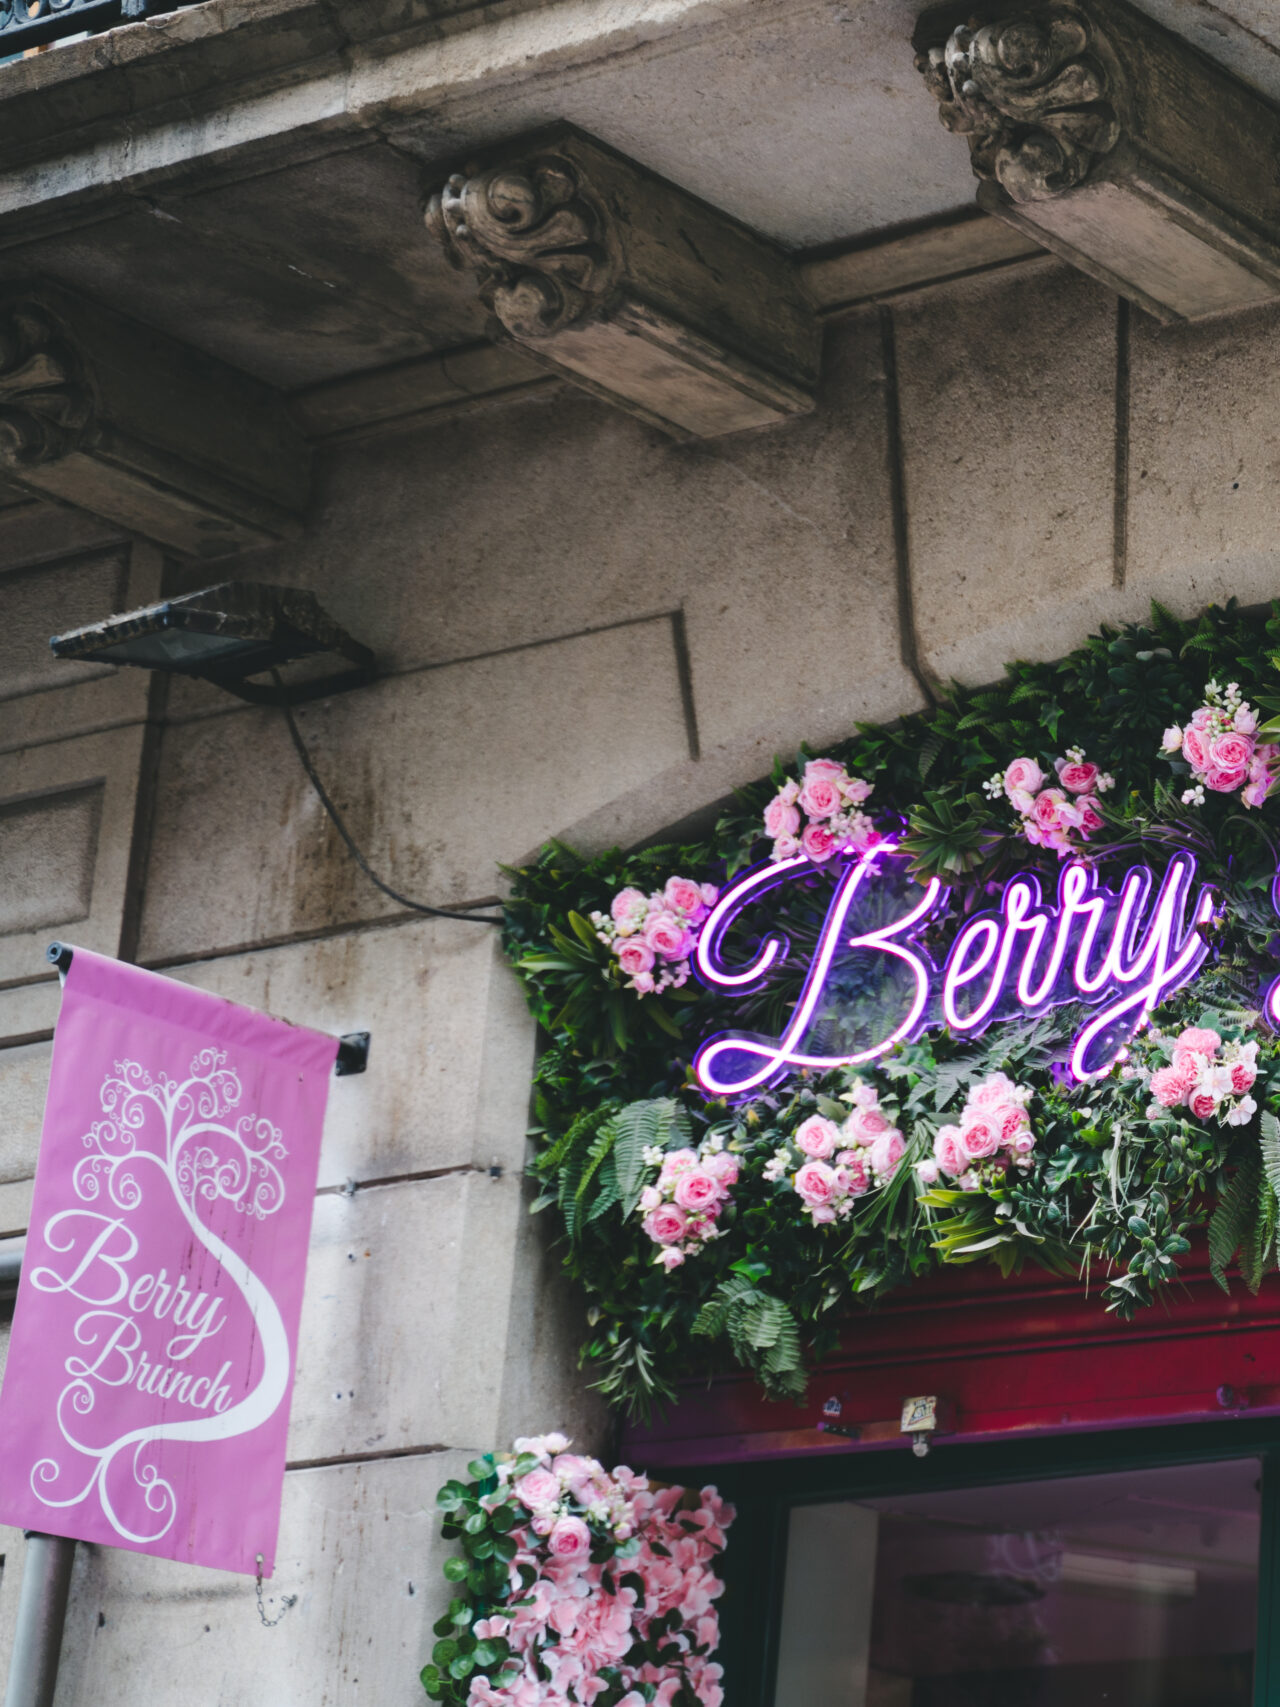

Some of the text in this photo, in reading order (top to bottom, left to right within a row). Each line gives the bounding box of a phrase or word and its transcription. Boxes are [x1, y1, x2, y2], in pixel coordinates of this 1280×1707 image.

[696, 841, 1213, 1095] Berry
[29, 1208, 228, 1361] Berry
[64, 1310, 233, 1414] Brunch
